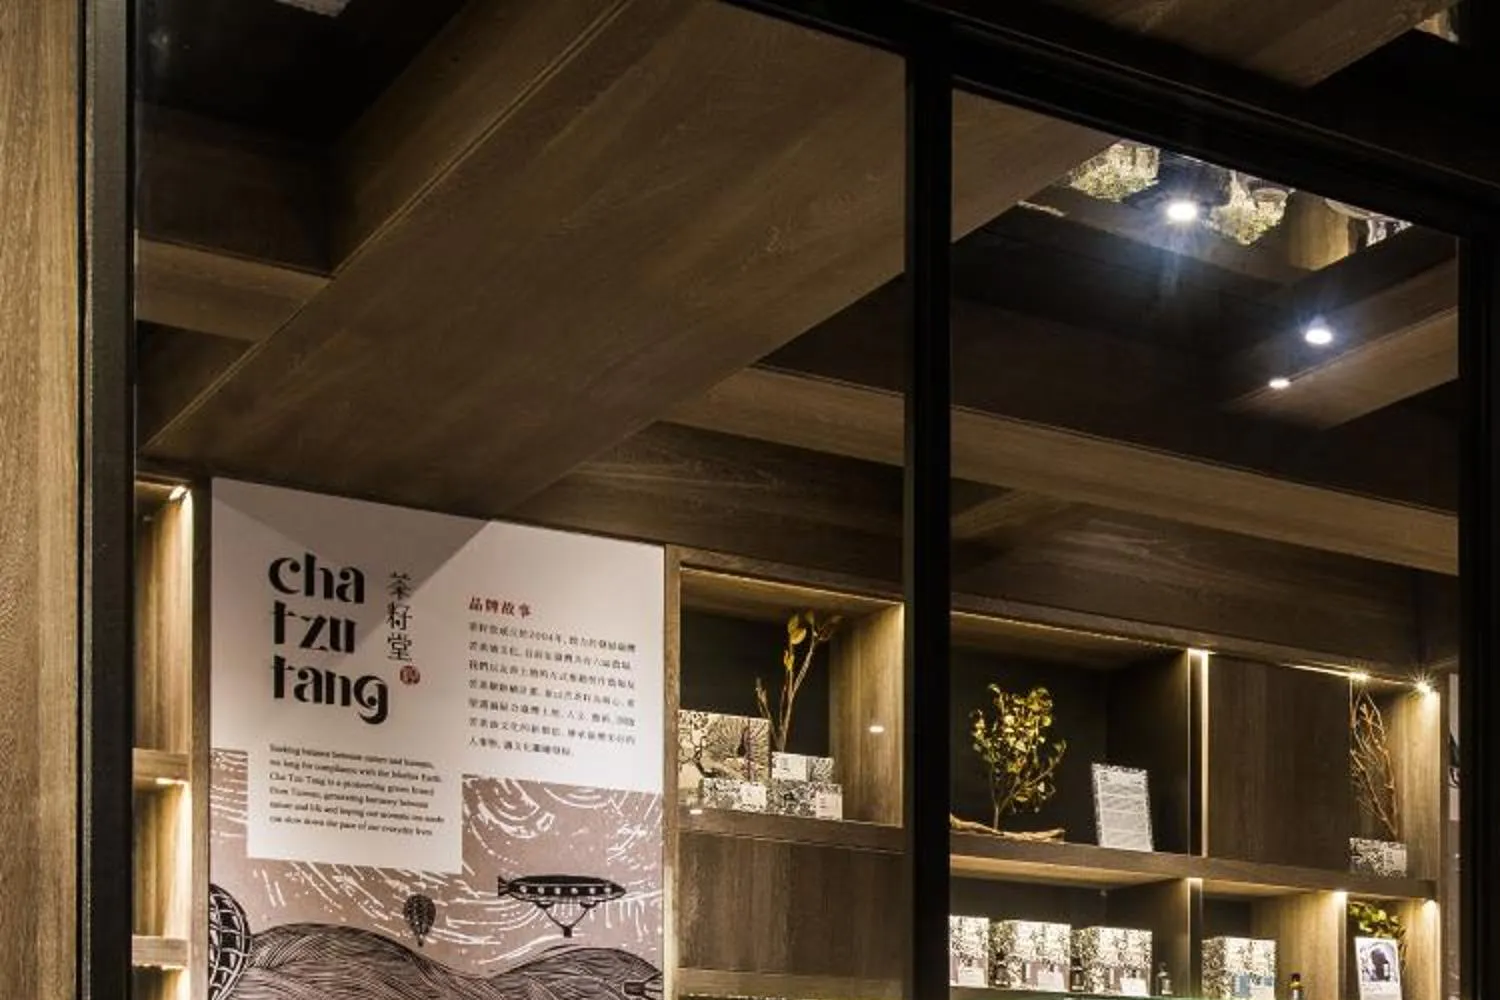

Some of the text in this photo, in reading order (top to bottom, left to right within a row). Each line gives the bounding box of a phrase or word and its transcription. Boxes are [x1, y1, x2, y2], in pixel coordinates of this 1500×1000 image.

[268, 553, 365, 604] cha
[269, 600, 356, 654] tzu
[386, 571, 414, 662] 茶籽堂
[468, 597, 532, 618] 品牌故事
[270, 655, 389, 725] tang
